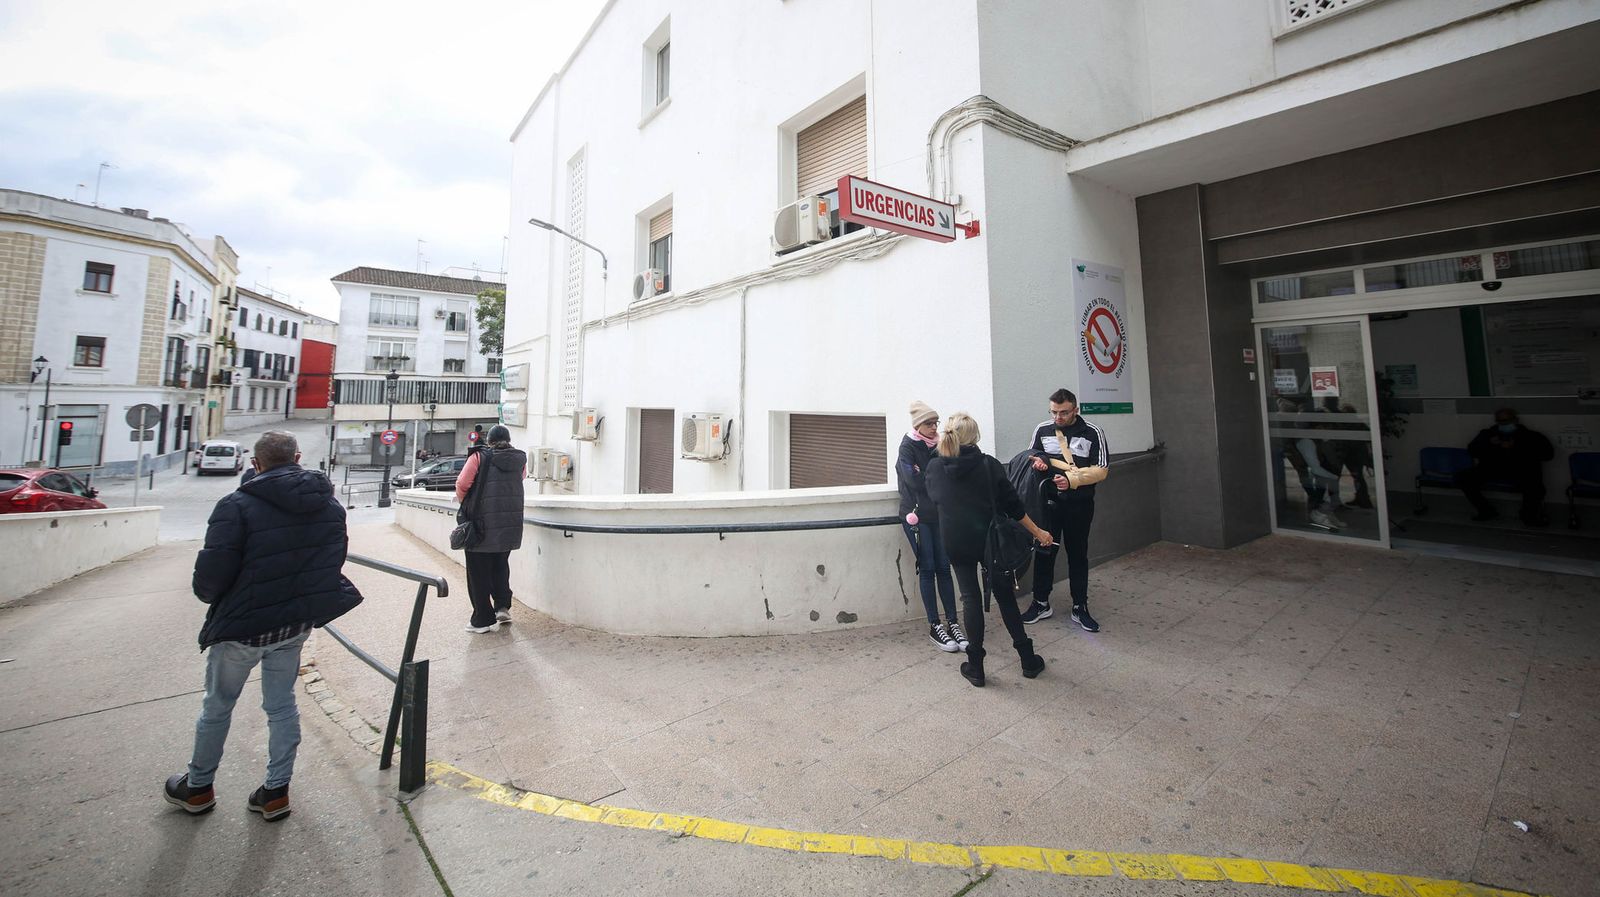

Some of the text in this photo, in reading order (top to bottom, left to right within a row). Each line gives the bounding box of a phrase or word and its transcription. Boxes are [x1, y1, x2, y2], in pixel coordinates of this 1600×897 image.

[854, 187, 935, 227] URGENCIAS
[1081, 303, 1092, 327] FUMAR
[1097, 297, 1110, 308] TODO
[1081, 331, 1095, 375] PROHIBIDO
